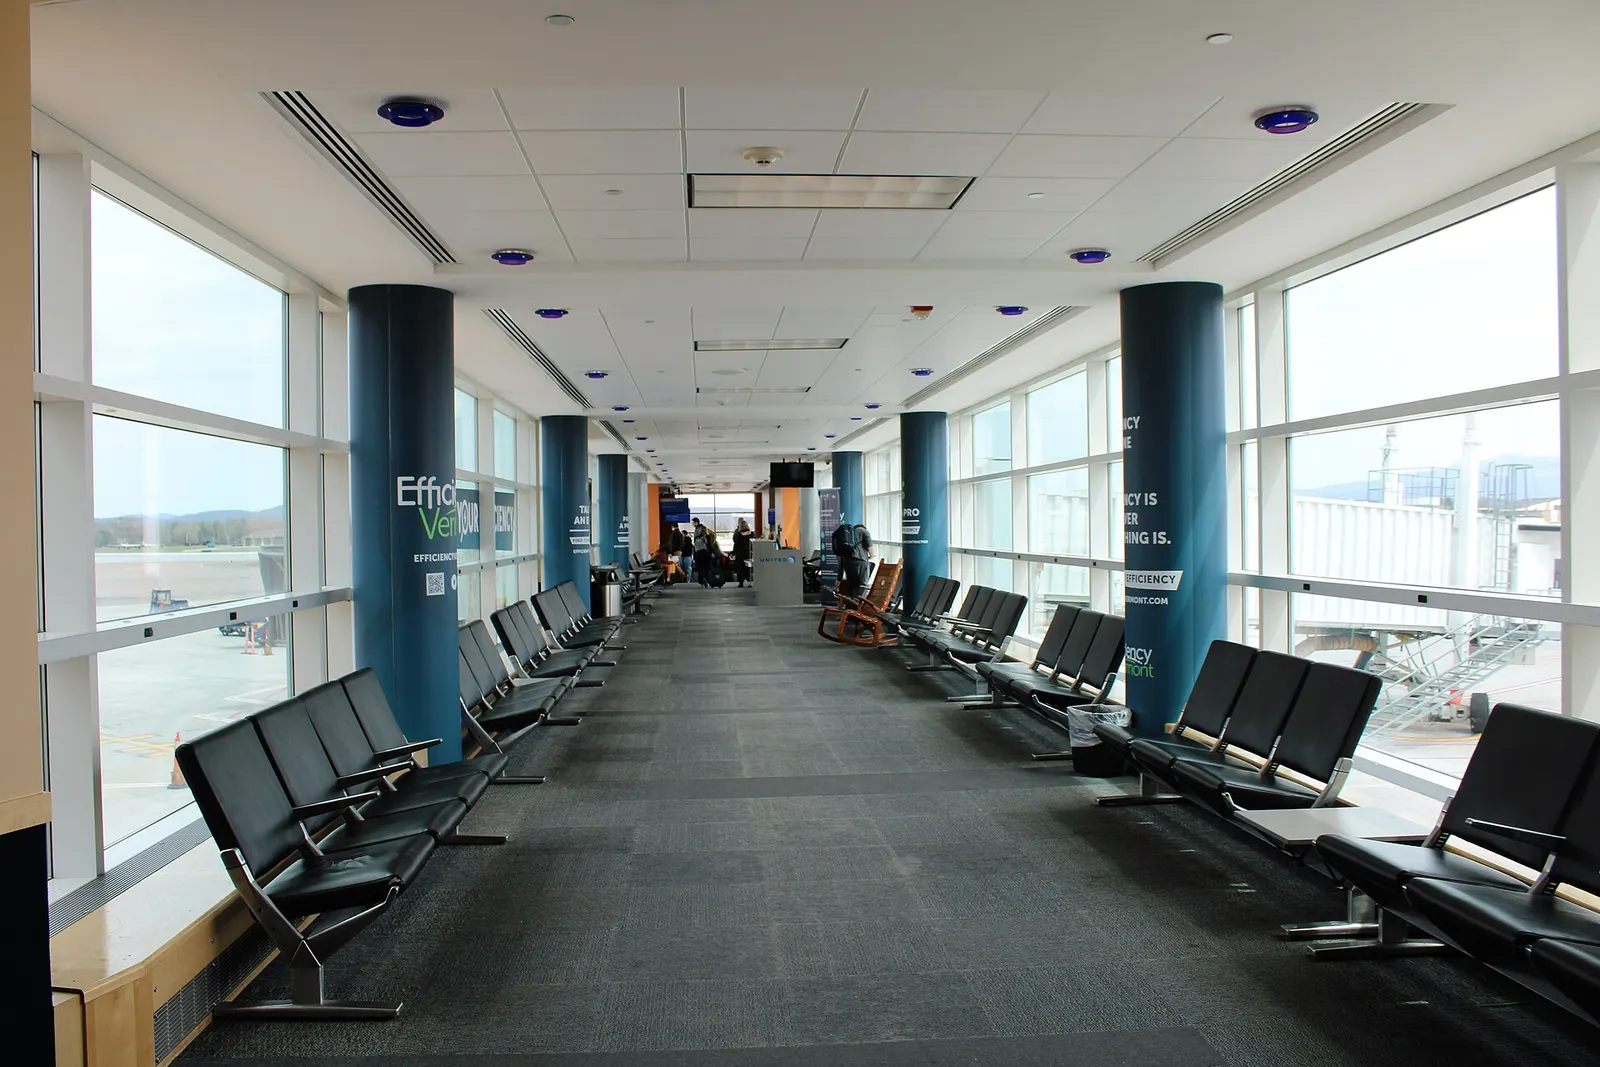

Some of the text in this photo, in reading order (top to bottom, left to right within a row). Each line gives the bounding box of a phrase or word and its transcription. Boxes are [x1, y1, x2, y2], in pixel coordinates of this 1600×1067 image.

[397, 476, 456, 509] Effici
[1144, 492, 1158, 506] IS
[903, 508, 920, 517] PRO
[457, 500, 479, 540] YOUR
[1152, 531, 1171, 545] IS.
[1126, 574, 1176, 584] EFFICIENCY
